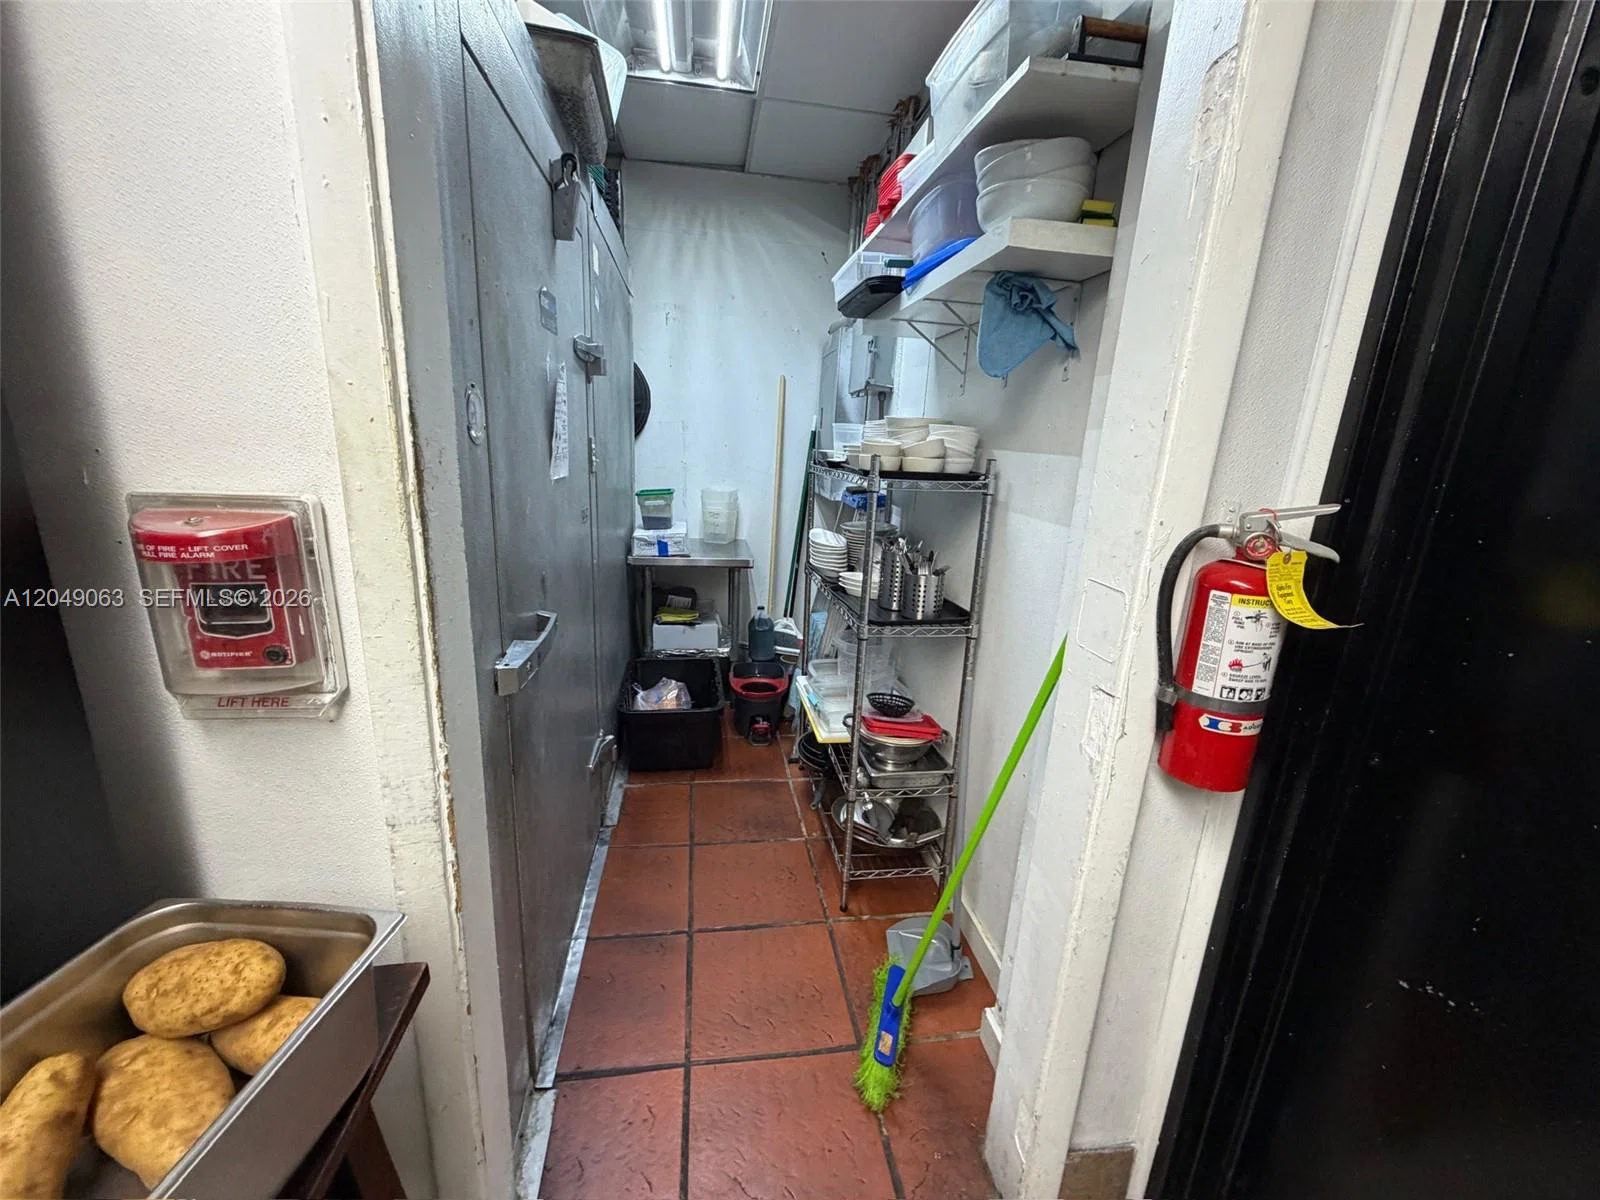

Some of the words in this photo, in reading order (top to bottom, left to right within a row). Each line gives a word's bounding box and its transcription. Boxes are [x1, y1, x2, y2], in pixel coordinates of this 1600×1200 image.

[213, 543, 249, 552] COVER
[180, 551, 215, 559] ALARM
[187, 560, 267, 580] FIRE
[217, 696, 248, 708] LIFT
[251, 696, 290, 708] HERE
